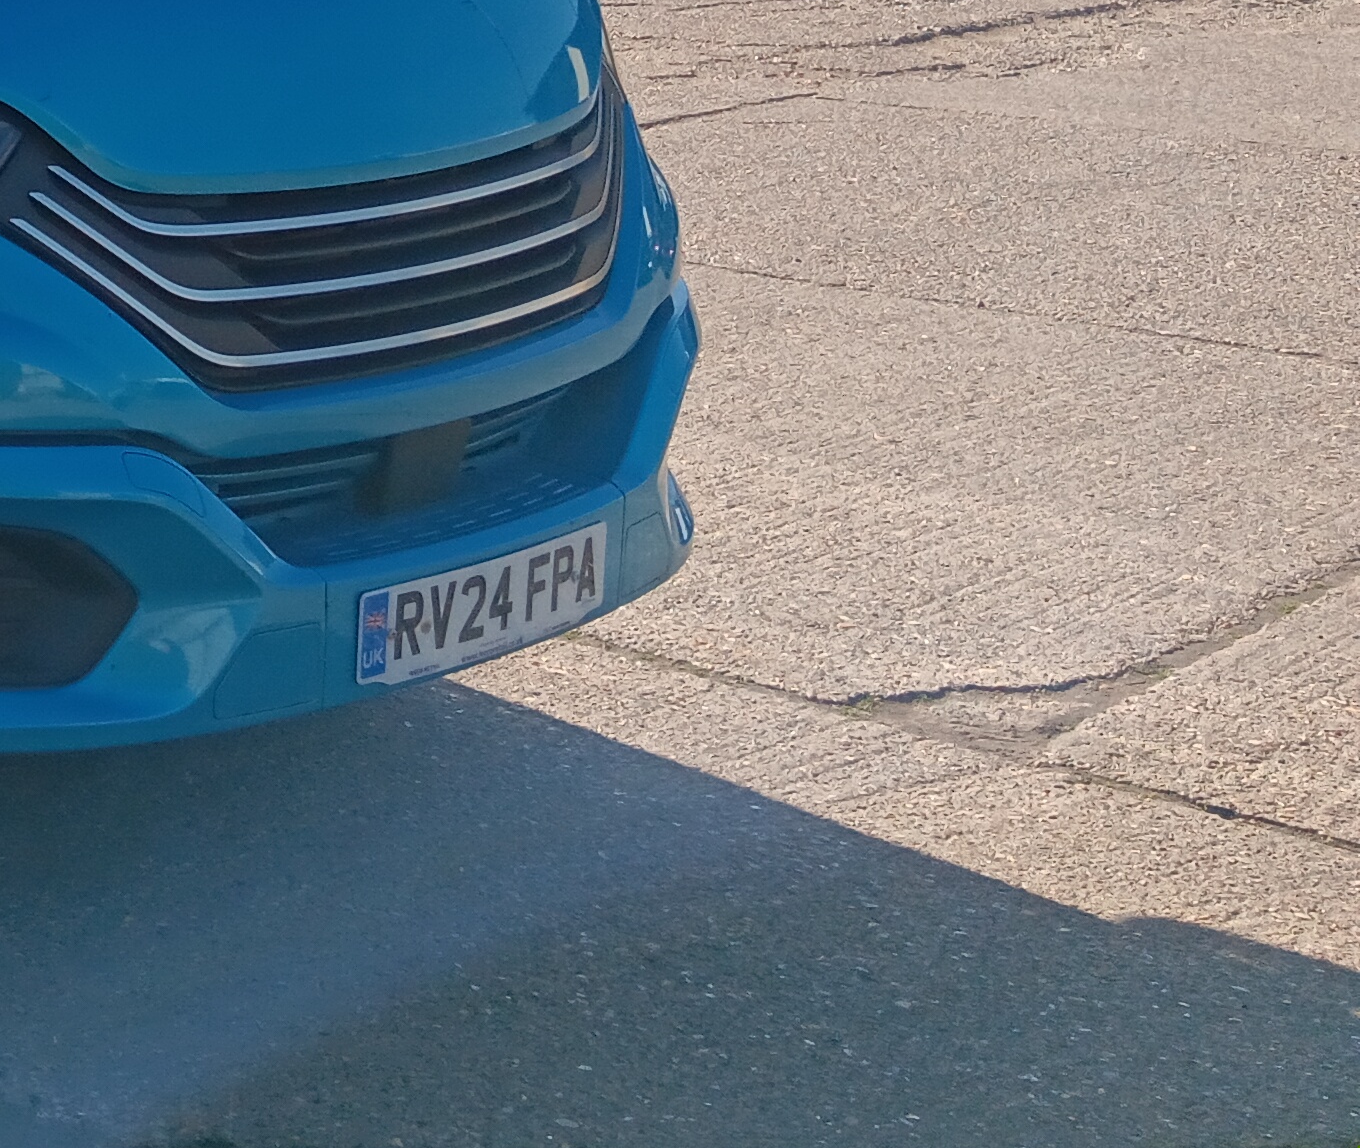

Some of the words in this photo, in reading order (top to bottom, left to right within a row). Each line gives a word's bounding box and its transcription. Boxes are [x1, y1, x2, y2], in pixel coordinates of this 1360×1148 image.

[393, 565, 514, 661] RV24
[524, 536, 597, 622] FPA
[363, 647, 384, 669] UK
